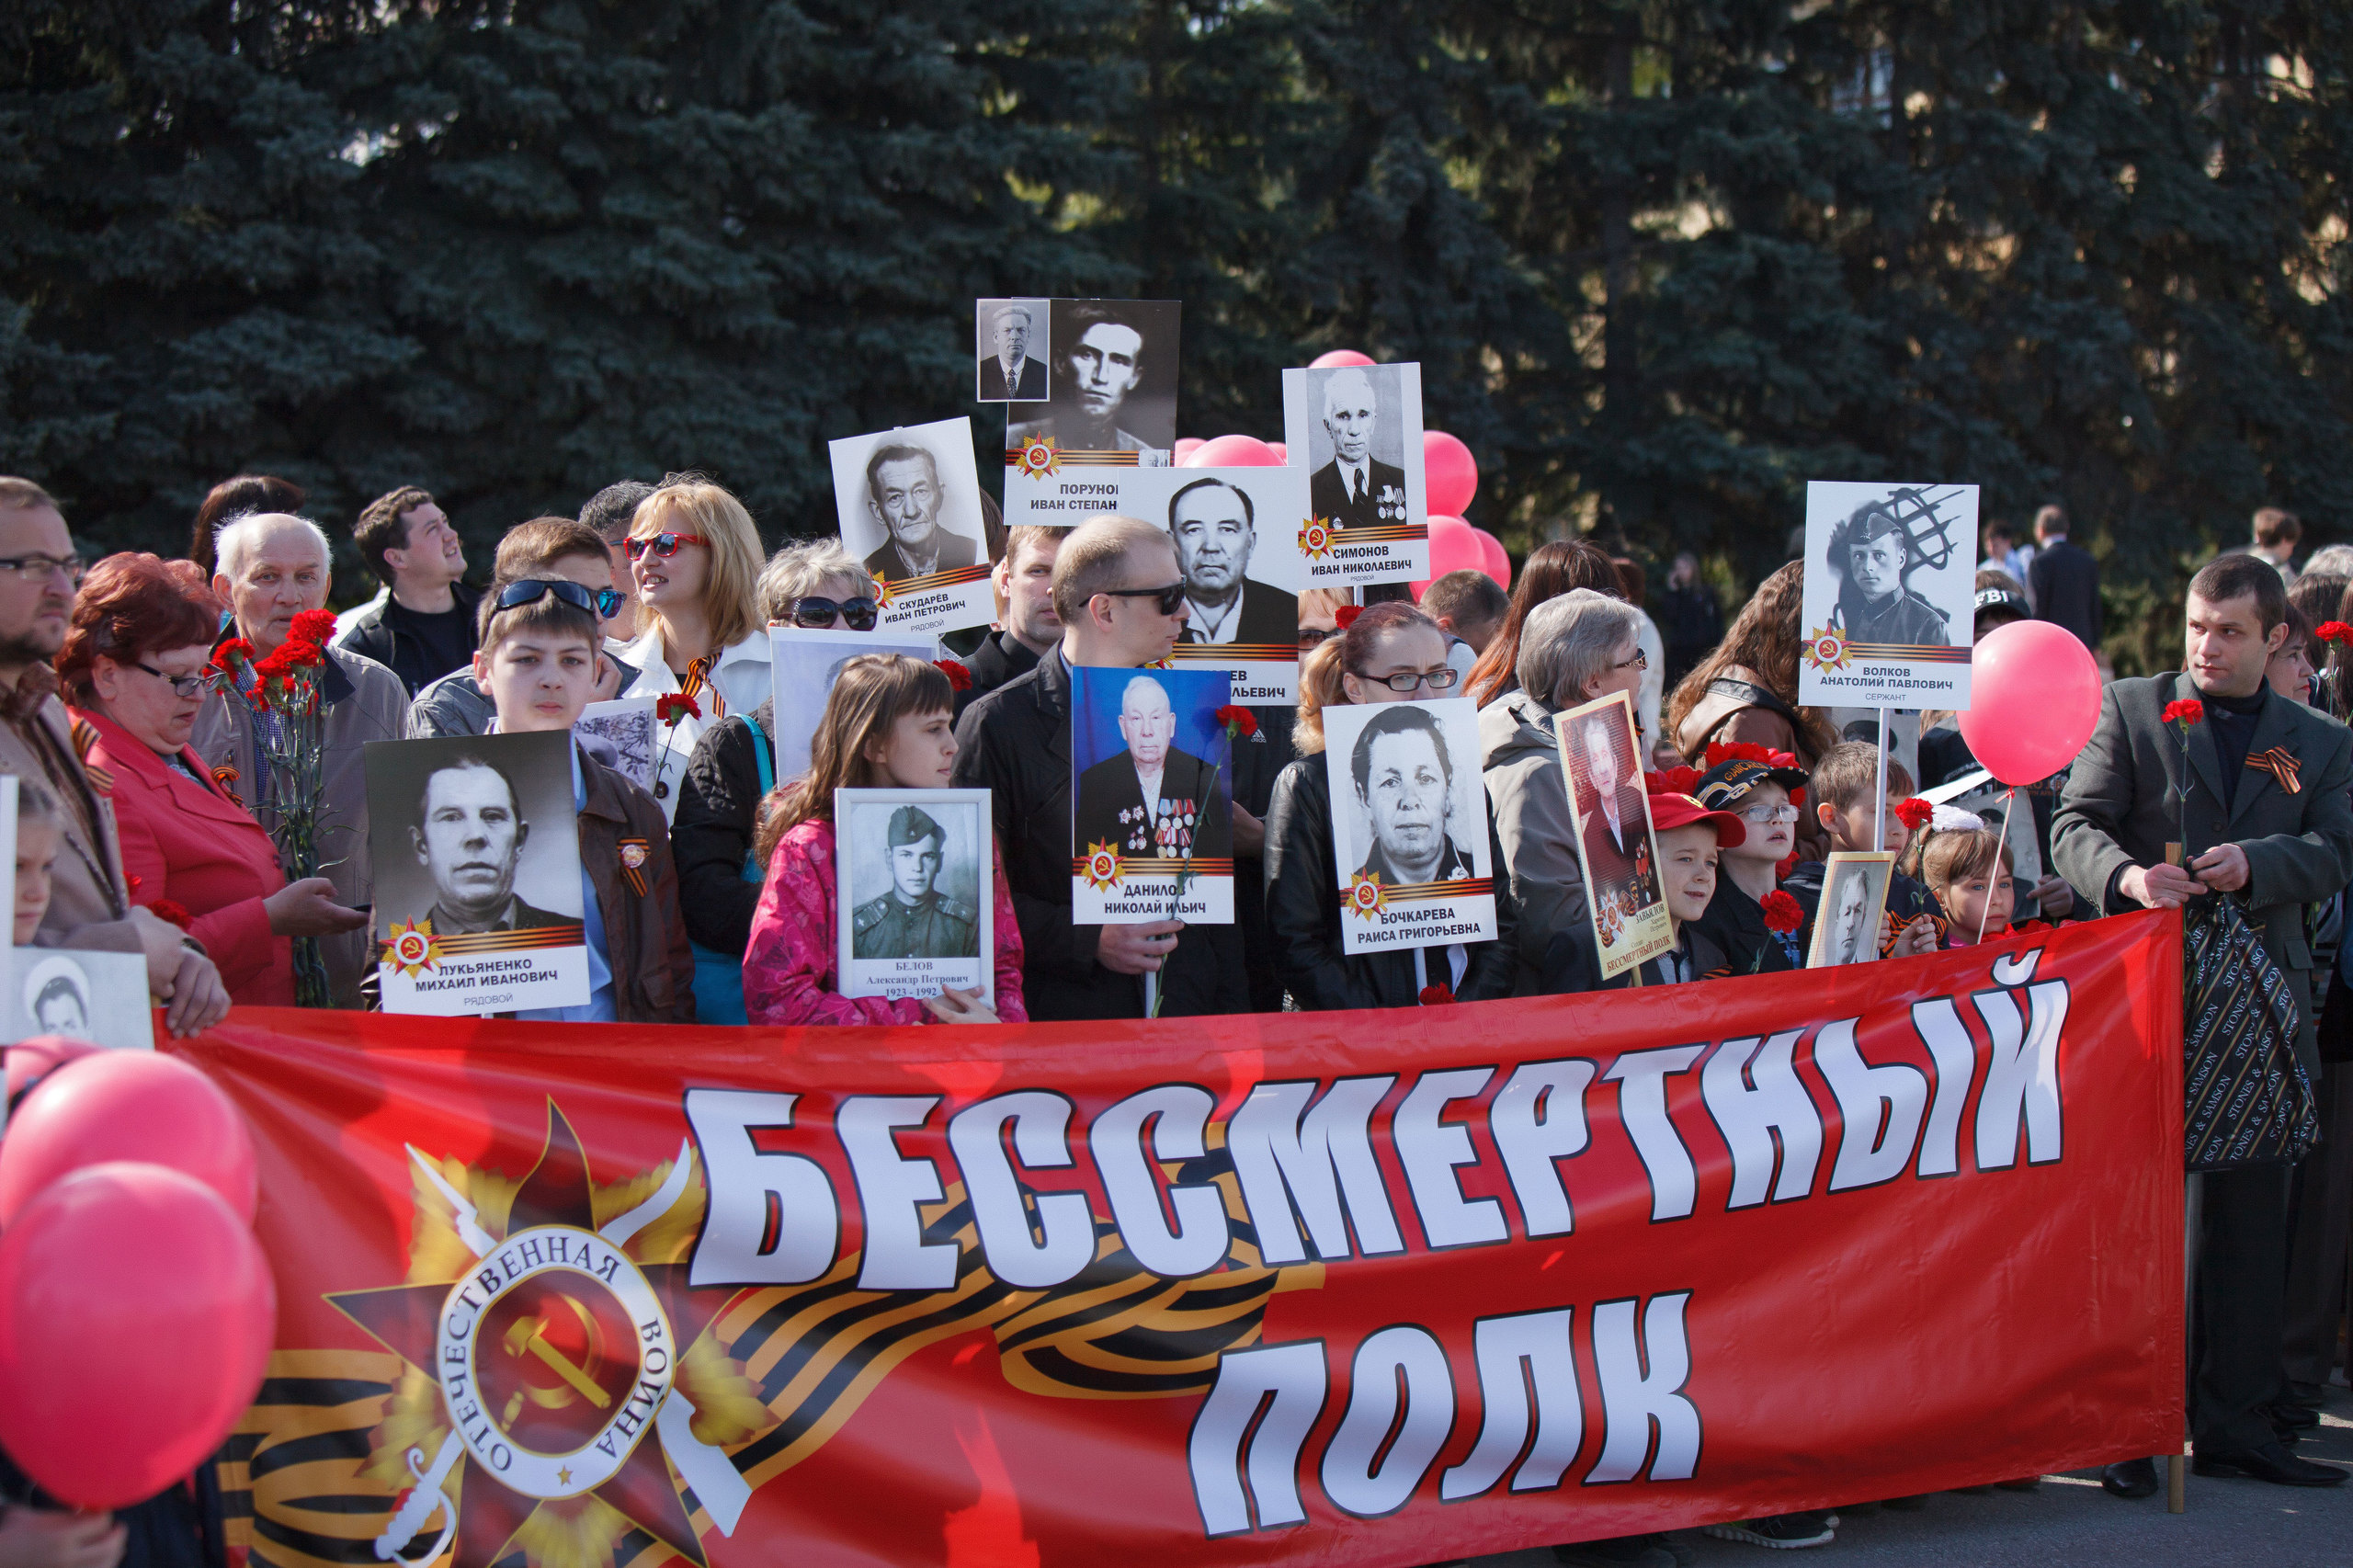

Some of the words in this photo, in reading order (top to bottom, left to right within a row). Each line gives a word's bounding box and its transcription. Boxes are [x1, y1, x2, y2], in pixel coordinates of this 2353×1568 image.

[1030, 499, 1065, 510] ИВАН
[1069, 500, 1119, 510] СТЕПАН
[1333, 546, 1389, 559] СИМОНОВ
[1312, 564, 1340, 575] ИВАН
[1343, 560, 1412, 574] НИКОЛАЕВИЧ
[899, 593, 949, 610] СКУДАРЁВ
[1973, 589, 2009, 609] FBI
[885, 610, 912, 624] ИВАН
[915, 600, 966, 618] ПЕТРОВИЧ
[911, 619, 945, 631] РЯДОВОЙ
[1231, 670, 1247, 681] ЕВ
[1863, 666, 1911, 676] ВОЛКОВ
[1820, 676, 1884, 687] АНАТОЛИЙ
[1888, 678, 1953, 689] ПАВЛОВИЧ
[1232, 687, 1286, 698] ЛЬЕВИЧ
[1865, 693, 1906, 701] СЕРЖАНТ
[1105, 900, 1162, 914] НИКОЛАЙ
[1165, 903, 1206, 914] ИЛЬИЧ
[1381, 907, 1455, 925] БОЧКАРЕВА
[1358, 930, 1396, 944] РАИСА
[1400, 923, 1481, 940] ГРИГОРЬЕВНА
[1606, 941, 1654, 971] БЕССМЕРТНЫЙ
[1654, 935, 1671, 950] ПОЛК
[439, 959, 532, 976] ЛУКЬЯНЕНКО
[895, 961, 933, 971] БЕЛОВ
[415, 977, 475, 992] МИХАИЛ
[481, 971, 558, 986] ИВАНОВИЧ
[866, 976, 918, 985] Александр
[921, 975, 969, 984] Петрович
[464, 993, 513, 1006] РЯДОВОЙ
[886, 988, 906, 997] 1923
[916, 988, 937, 996] 1992
[2189, 1003, 2219, 1047] SAMSON
[2188, 1051, 2219, 1095] SAMSON
[2195, 1120, 2206, 1131] &
[2202, 1074, 2232, 1119] SAMSON
[2227, 1079, 2255, 1120] STONES
[2251, 1068, 2261, 1078] &
[685, 948, 2070, 1290] БЕССМЕРТНЫЙ
[2228, 1127, 2255, 1161] TONES
[2251, 1116, 2262, 1126] &
[445, 1236, 621, 1471] ОТЕЧЕСТВЕННАЯ
[596, 1316, 668, 1460] ВОЙНА
[1186, 1290, 1701, 1538] ПОЛК
